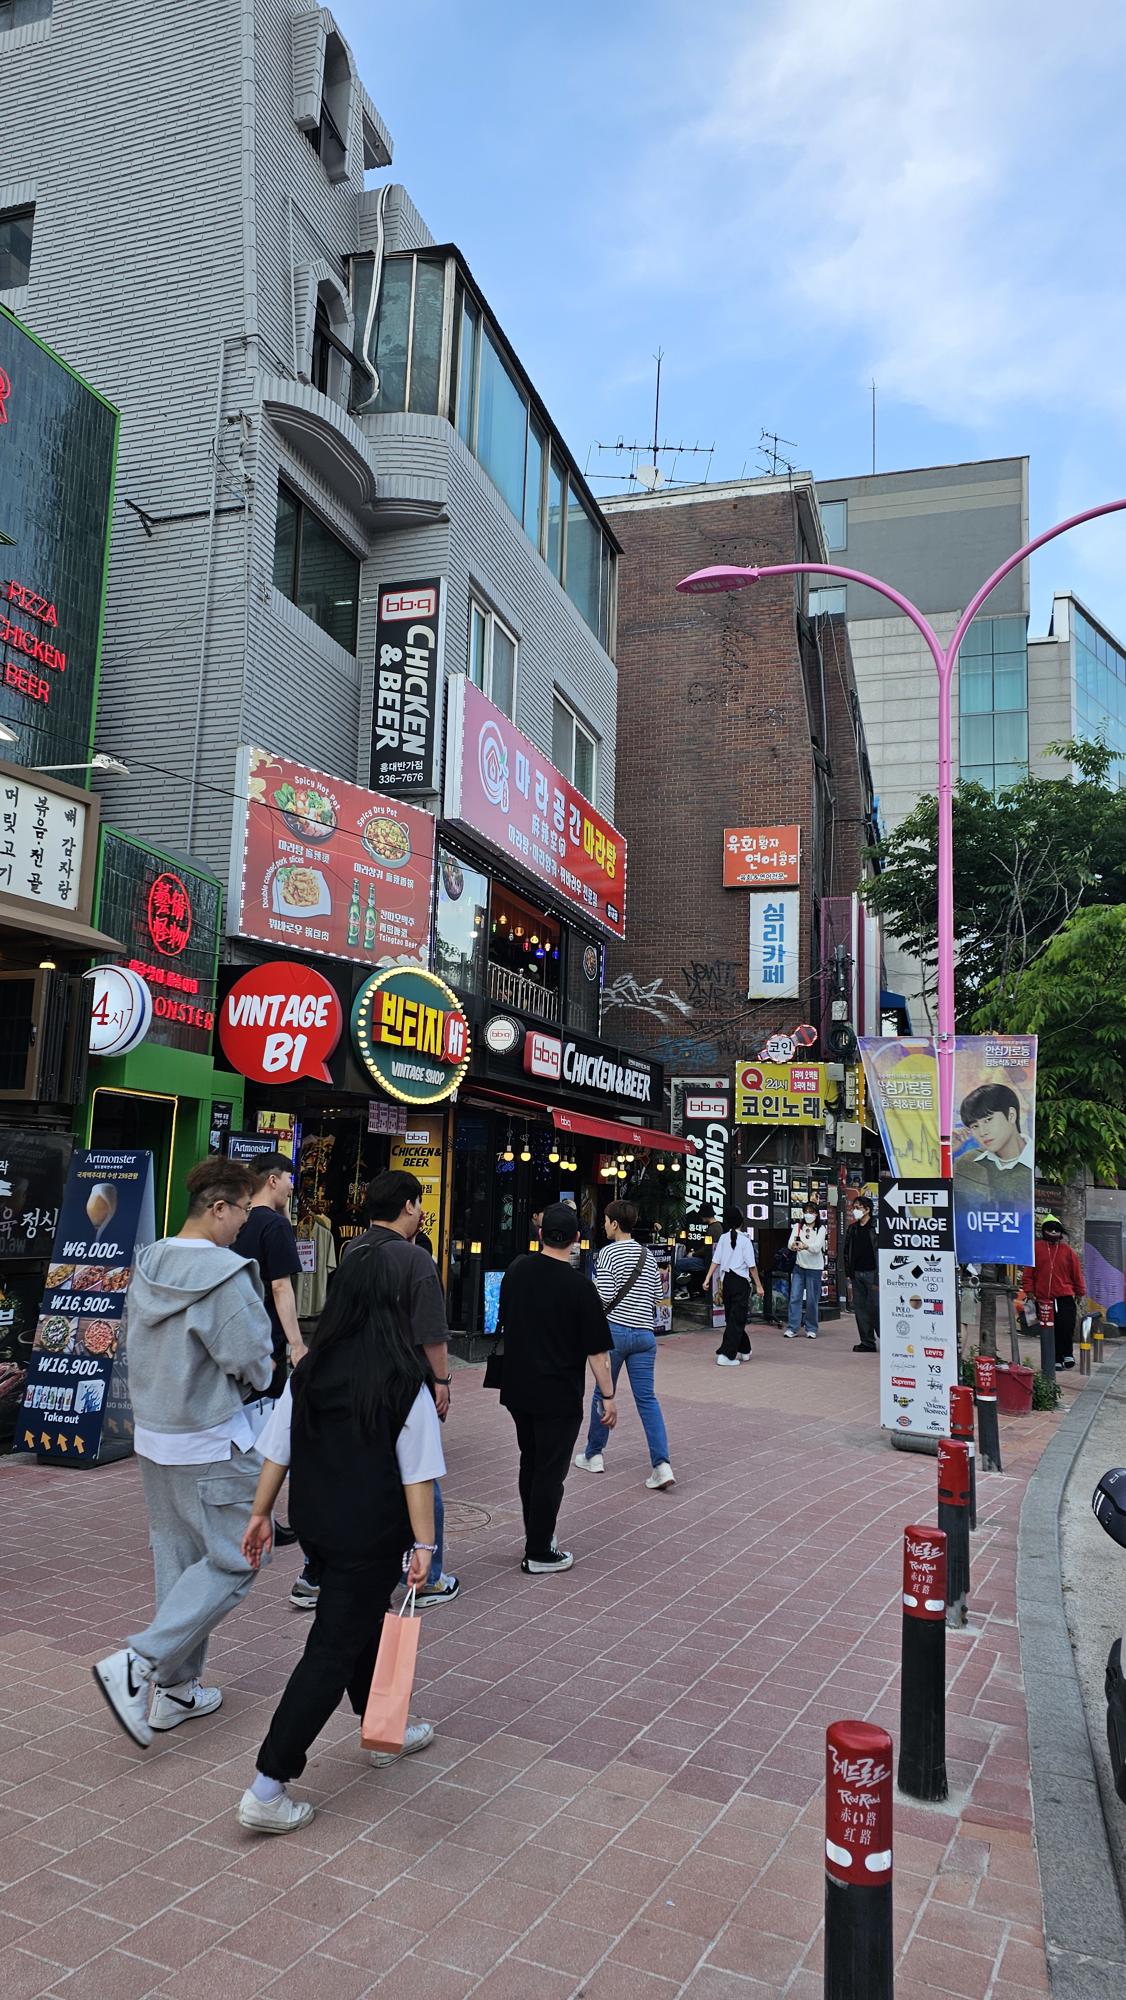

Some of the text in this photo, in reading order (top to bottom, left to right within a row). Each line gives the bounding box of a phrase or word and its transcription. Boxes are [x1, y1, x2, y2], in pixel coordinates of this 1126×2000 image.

[8, 580, 58, 628] PIZZA
[5, 662, 50, 703] BEER
[401, 624, 436, 756] CHICKEN
[375, 643, 403, 750] & BEER
[379, 760, 423, 772] 홍대반가점
[378, 773, 424, 784] 336-7676
[294, 776, 341, 810] Spicy Hot Pot
[356, 806, 398, 828] Spicy Dry Pot
[515, 750, 617, 879] 마라공간 마라탕
[278, 839, 303, 856] 마라탕
[404, 940, 418, 949] Beer
[762, 903, 785, 984] 심리카페
[228, 994, 333, 1028] VINTAGE
[381, 992, 444, 1056] 빈티지
[448, 1019, 463, 1057] Hi
[769, 1041, 791, 1055] 코인
[985, 1045, 1031, 1056] 안심가로등
[391, 1061, 445, 1086] VINTAGE SHOP
[741, 1068, 764, 1092] Q
[765, 1079, 788, 1091] 24시
[741, 1095, 827, 1119] 코인노래
[234, 1142, 270, 1153] Artmonster
[85, 1153, 137, 1164] Artmonster
[403, 1157, 429, 1168] BEER
[904, 1192, 938, 1205] LEFT
[20, 1207, 60, 1240] 정식
[886, 1217, 947, 1231] VINTAGE
[967, 1210, 1020, 1234] 이무진
[893, 1234, 940, 1248] STORE
[893, 1255, 910, 1264] NIKE
[892, 1377, 915, 1386] Supreme
[43, 1412, 80, 1425] Take out
[828, 1744, 891, 1788] 레드로드
